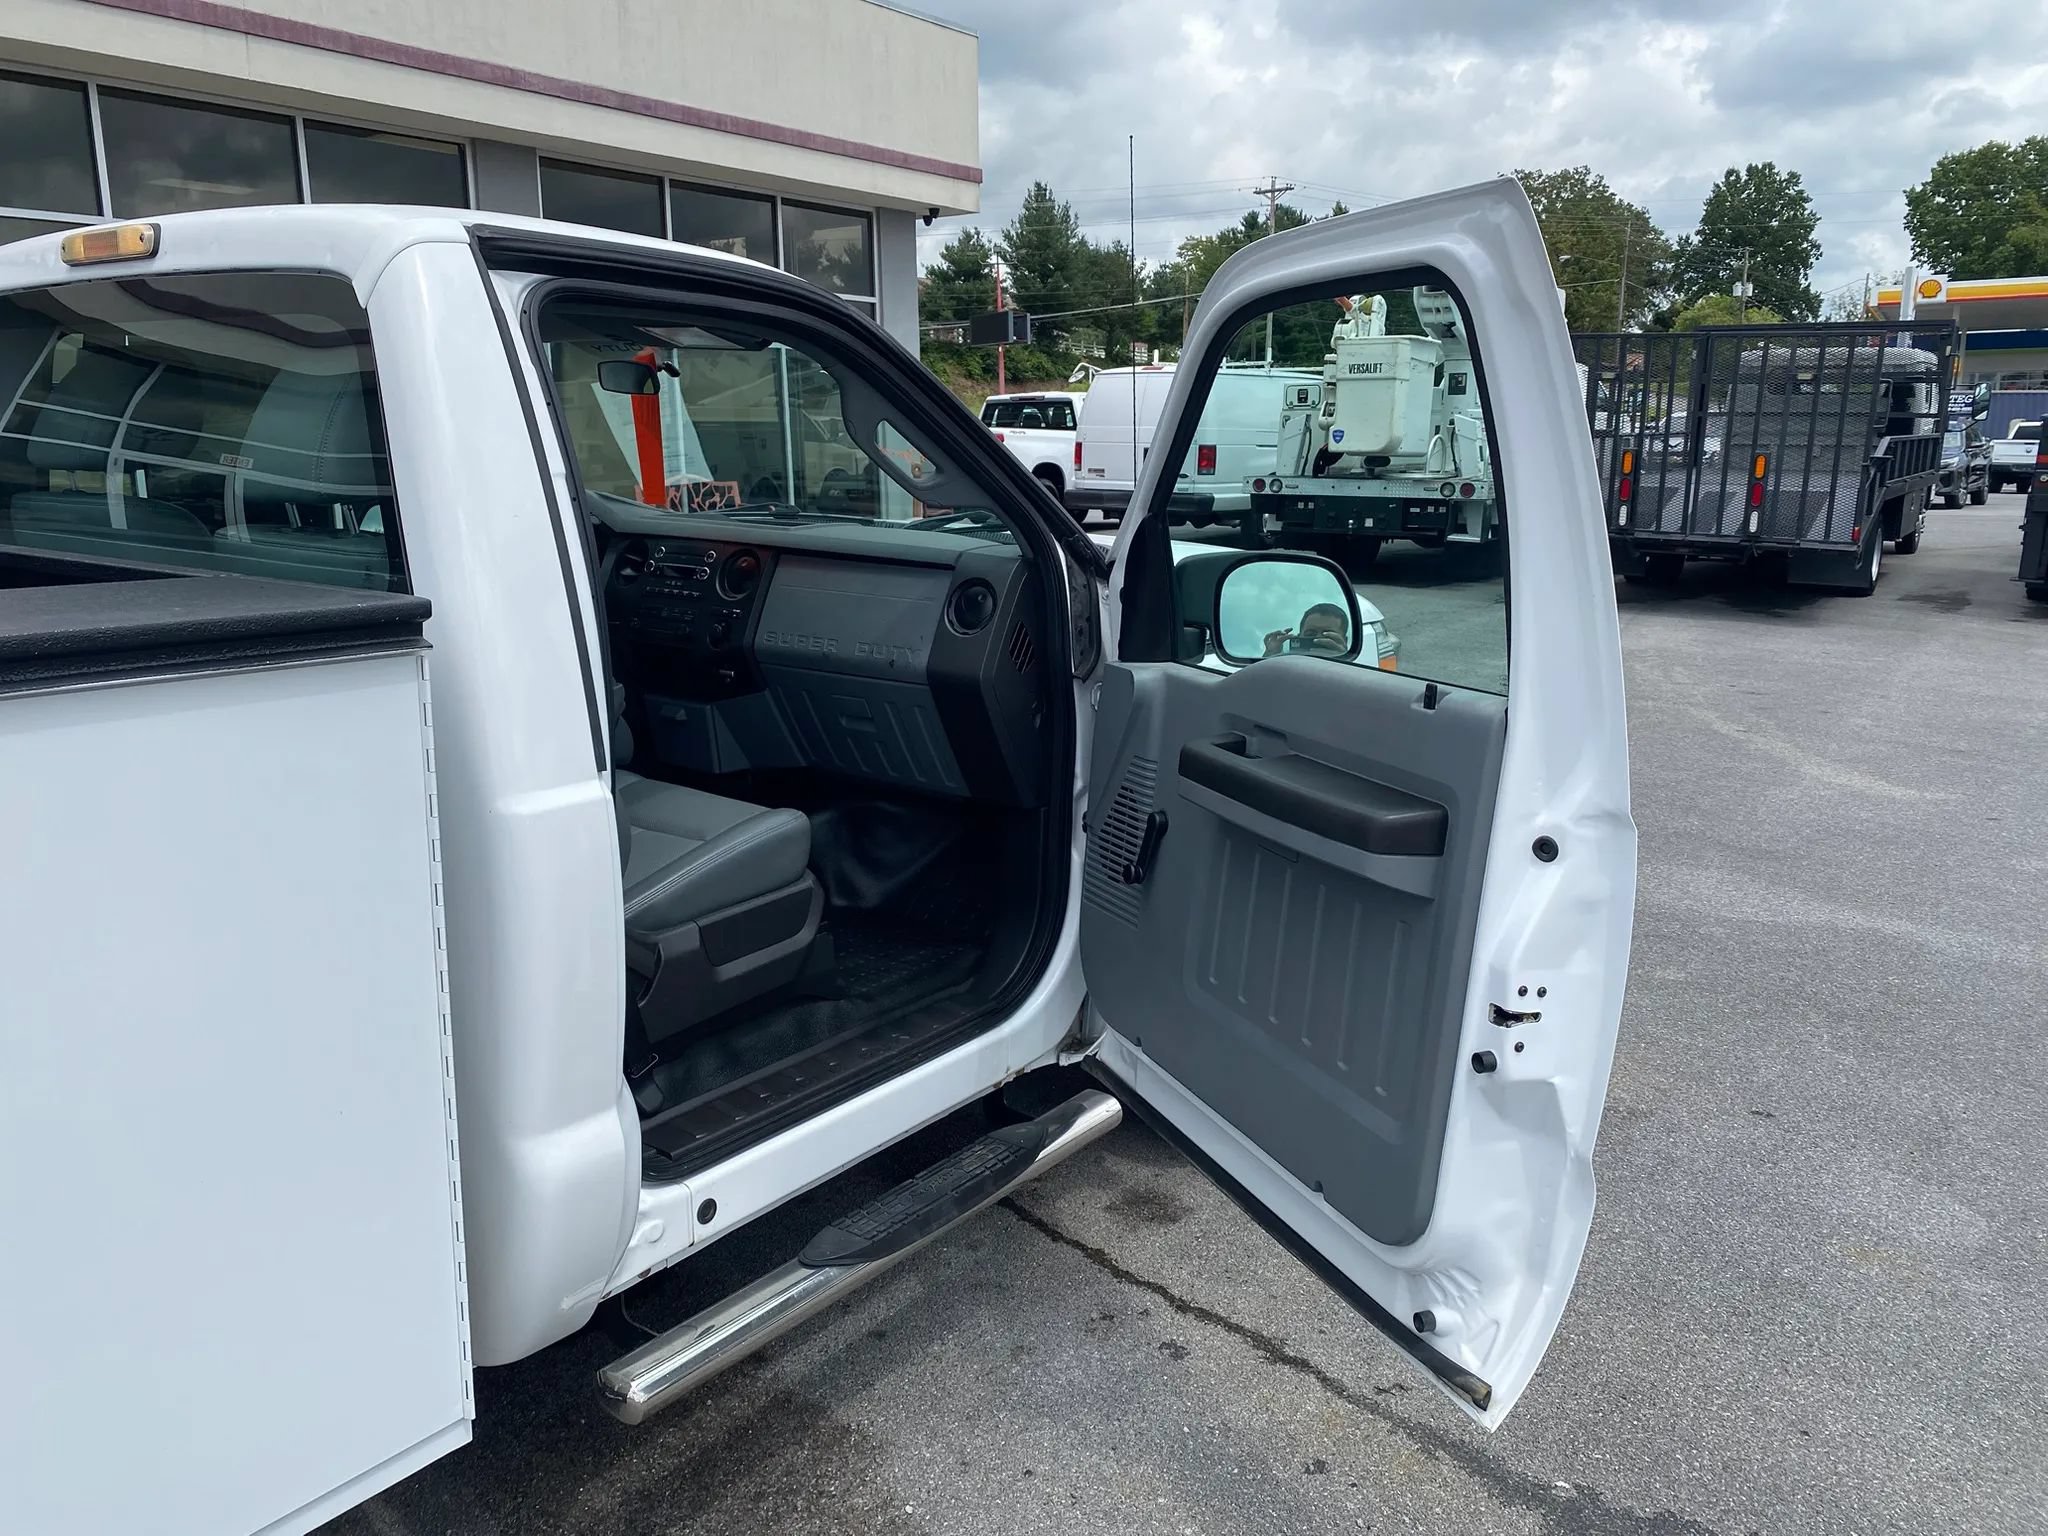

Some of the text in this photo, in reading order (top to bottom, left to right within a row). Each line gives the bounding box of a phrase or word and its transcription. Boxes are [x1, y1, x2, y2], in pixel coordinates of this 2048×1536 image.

[1348, 362, 1383, 374] VERSALIFT
[764, 631, 923, 664] SUPER DUTY
